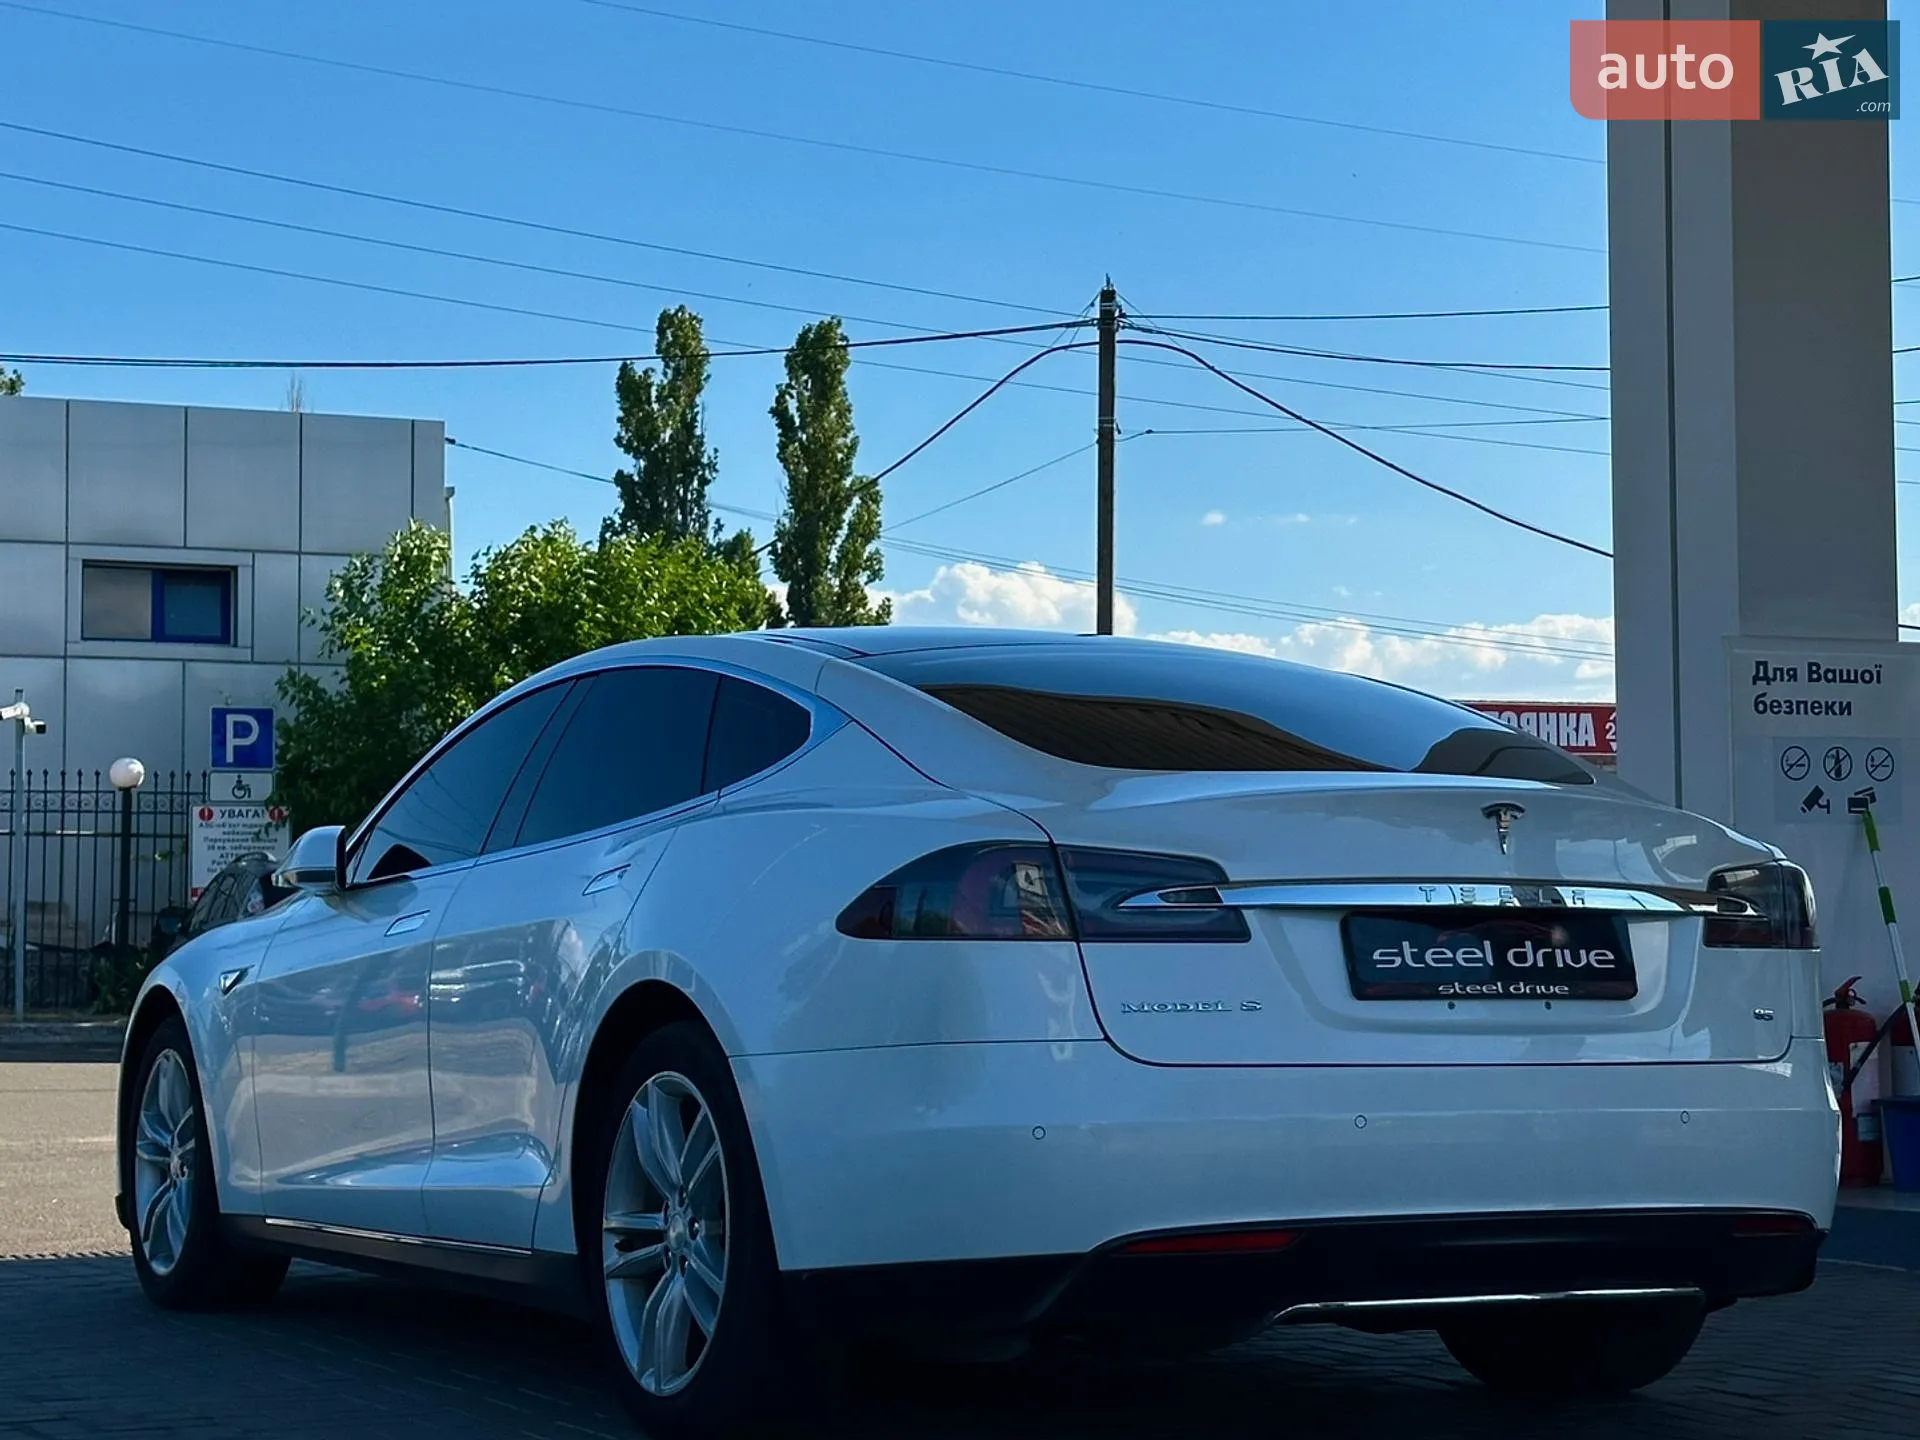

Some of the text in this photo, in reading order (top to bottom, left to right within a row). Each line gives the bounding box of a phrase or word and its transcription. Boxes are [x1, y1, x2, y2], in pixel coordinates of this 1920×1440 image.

[1752, 660, 1883, 686] Для Вашої
[1754, 692, 1852, 716] безпеки
[225, 713, 260, 763] P
[1418, 885, 1586, 906] TESLA
[1372, 940, 1616, 969] steel drive
[1438, 981, 1570, 995] steel drive
[1121, 999, 1263, 1013] MODEL S
